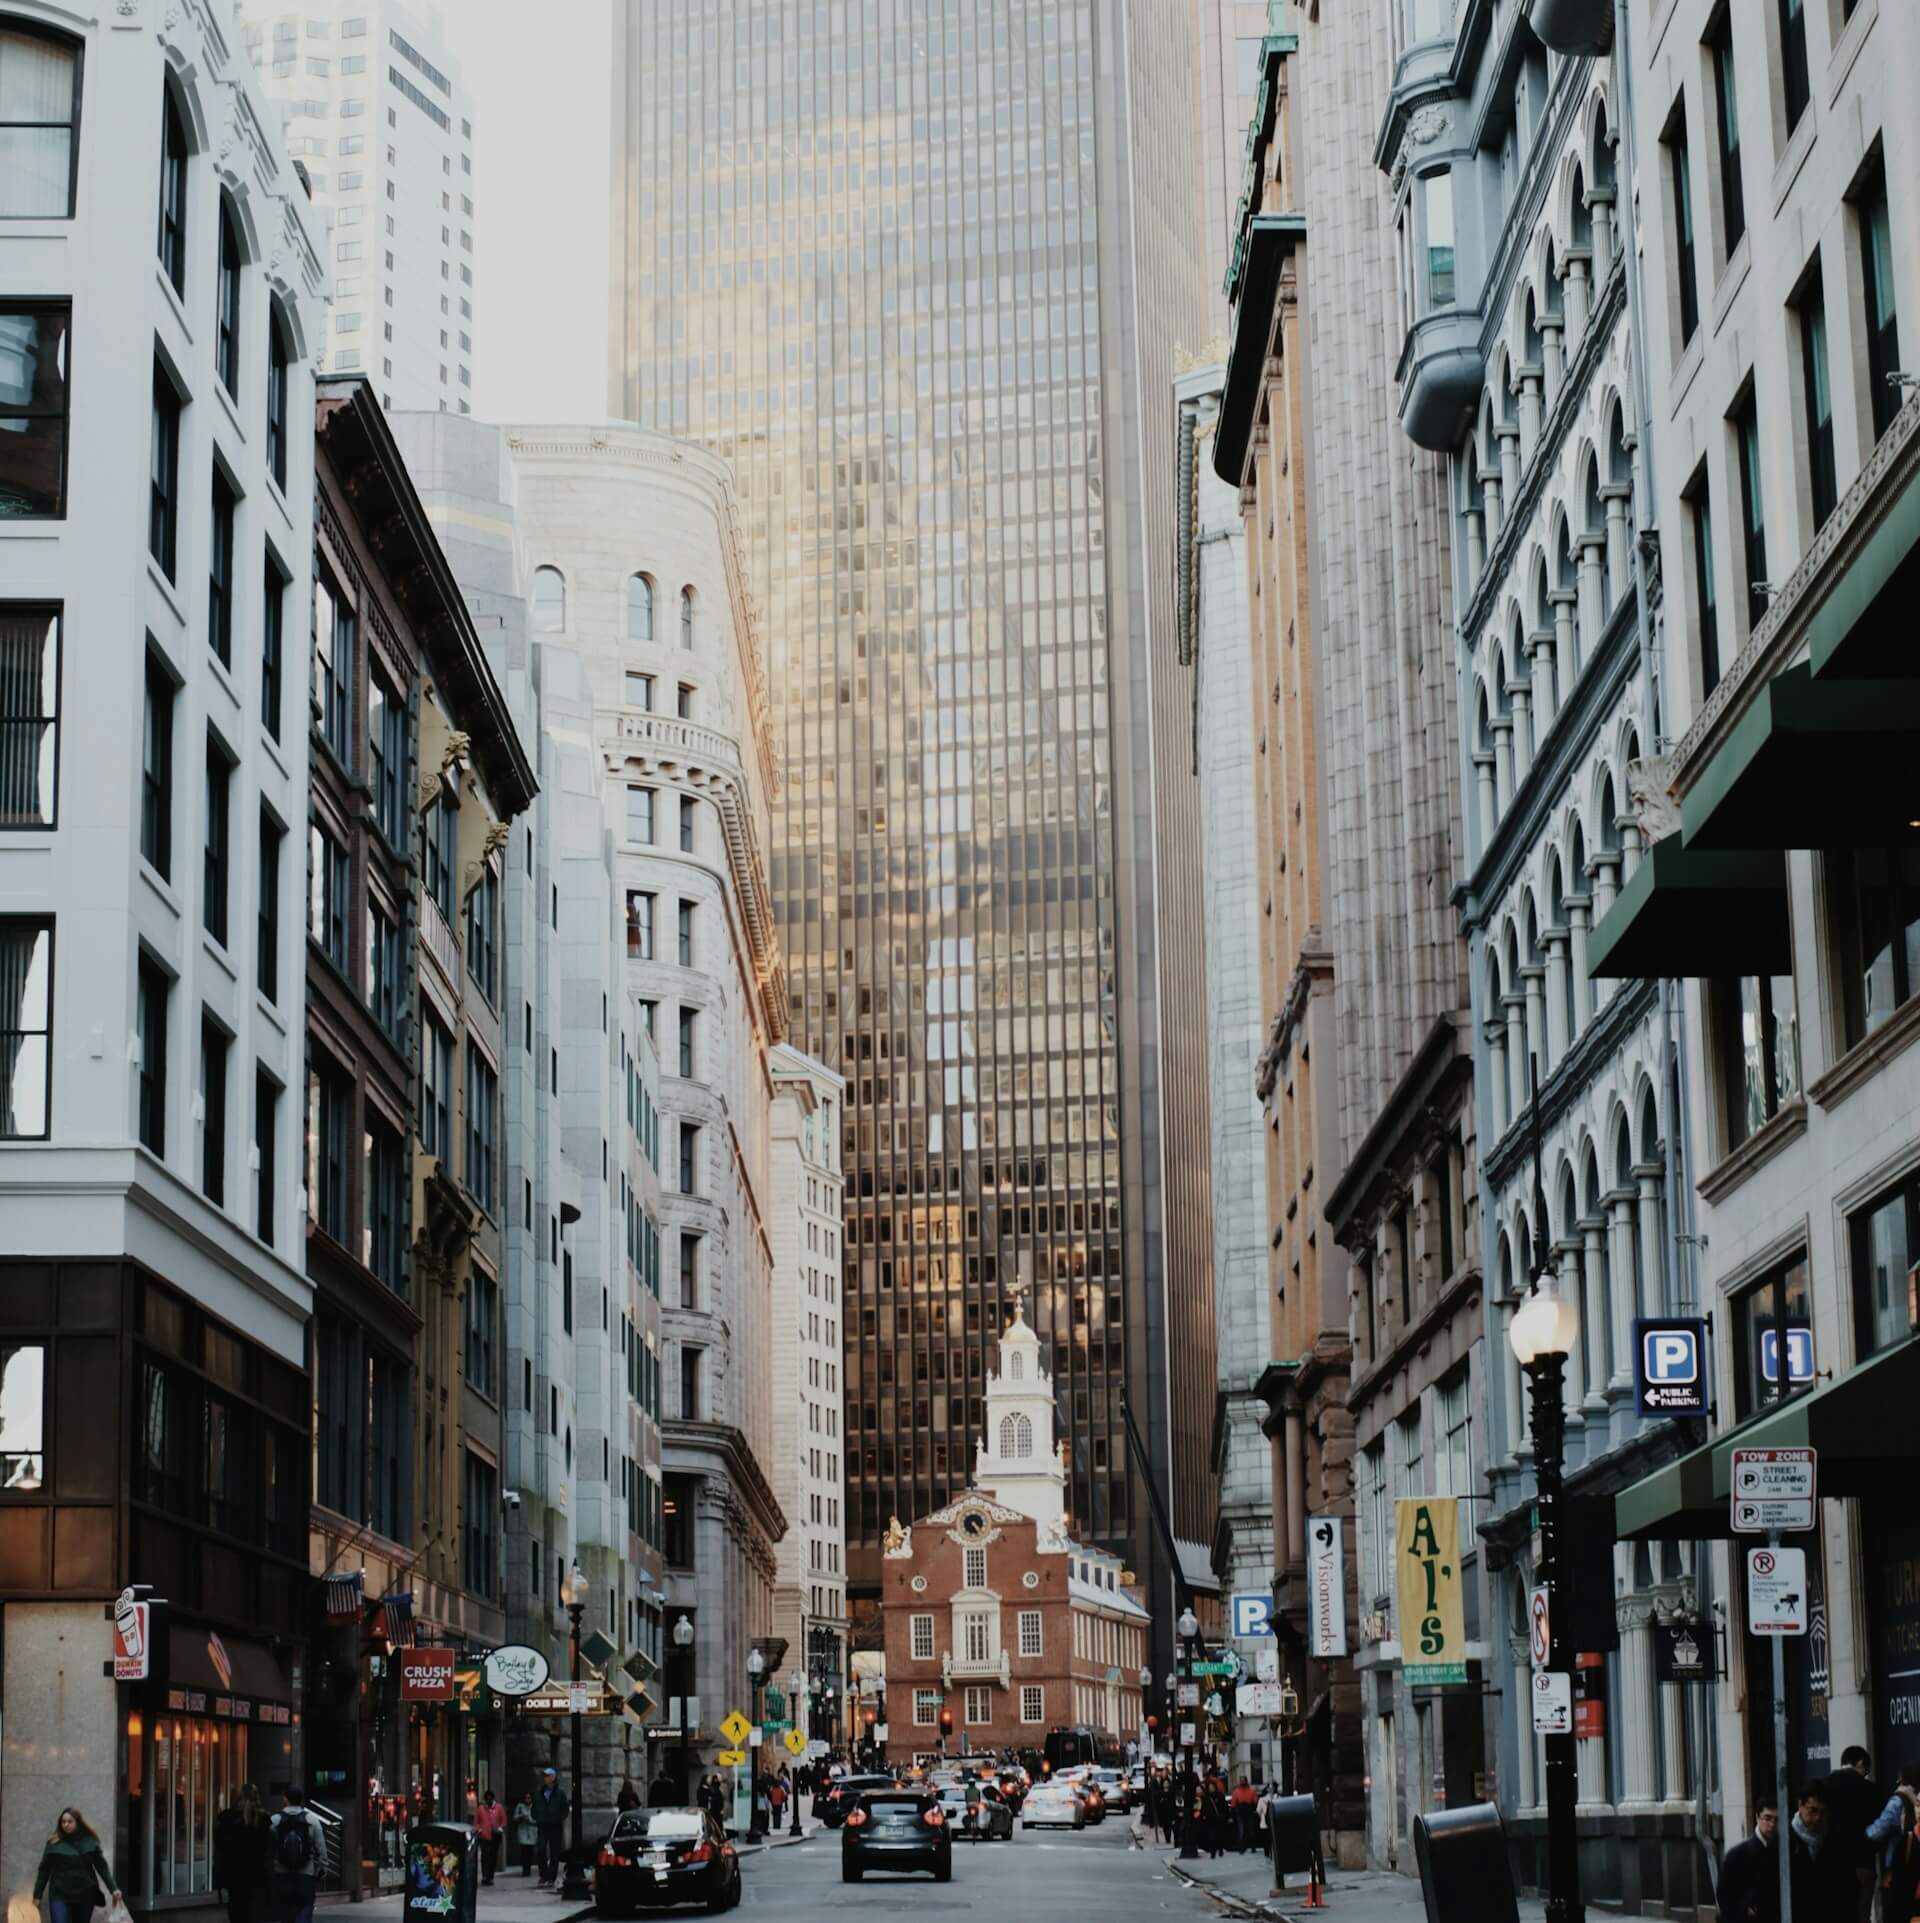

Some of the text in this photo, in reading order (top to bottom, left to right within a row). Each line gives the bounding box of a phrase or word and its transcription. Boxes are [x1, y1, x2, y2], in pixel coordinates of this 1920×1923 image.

[1655, 1336, 1689, 1378] P
[1661, 1388, 1692, 1398] PUBLIC
[1661, 1397, 1699, 1406] PARKING
[1741, 1452, 1808, 1461] TOW ZONE
[1763, 1475, 1806, 1483] CLEANING
[1318, 1551, 1337, 1653] Visionworks
[1238, 1599, 1268, 1634] P
[116, 1669, 143, 1677] DONUTS
[404, 1666, 451, 1678] CRUSH
[409, 1679, 445, 1688] PIZZA
